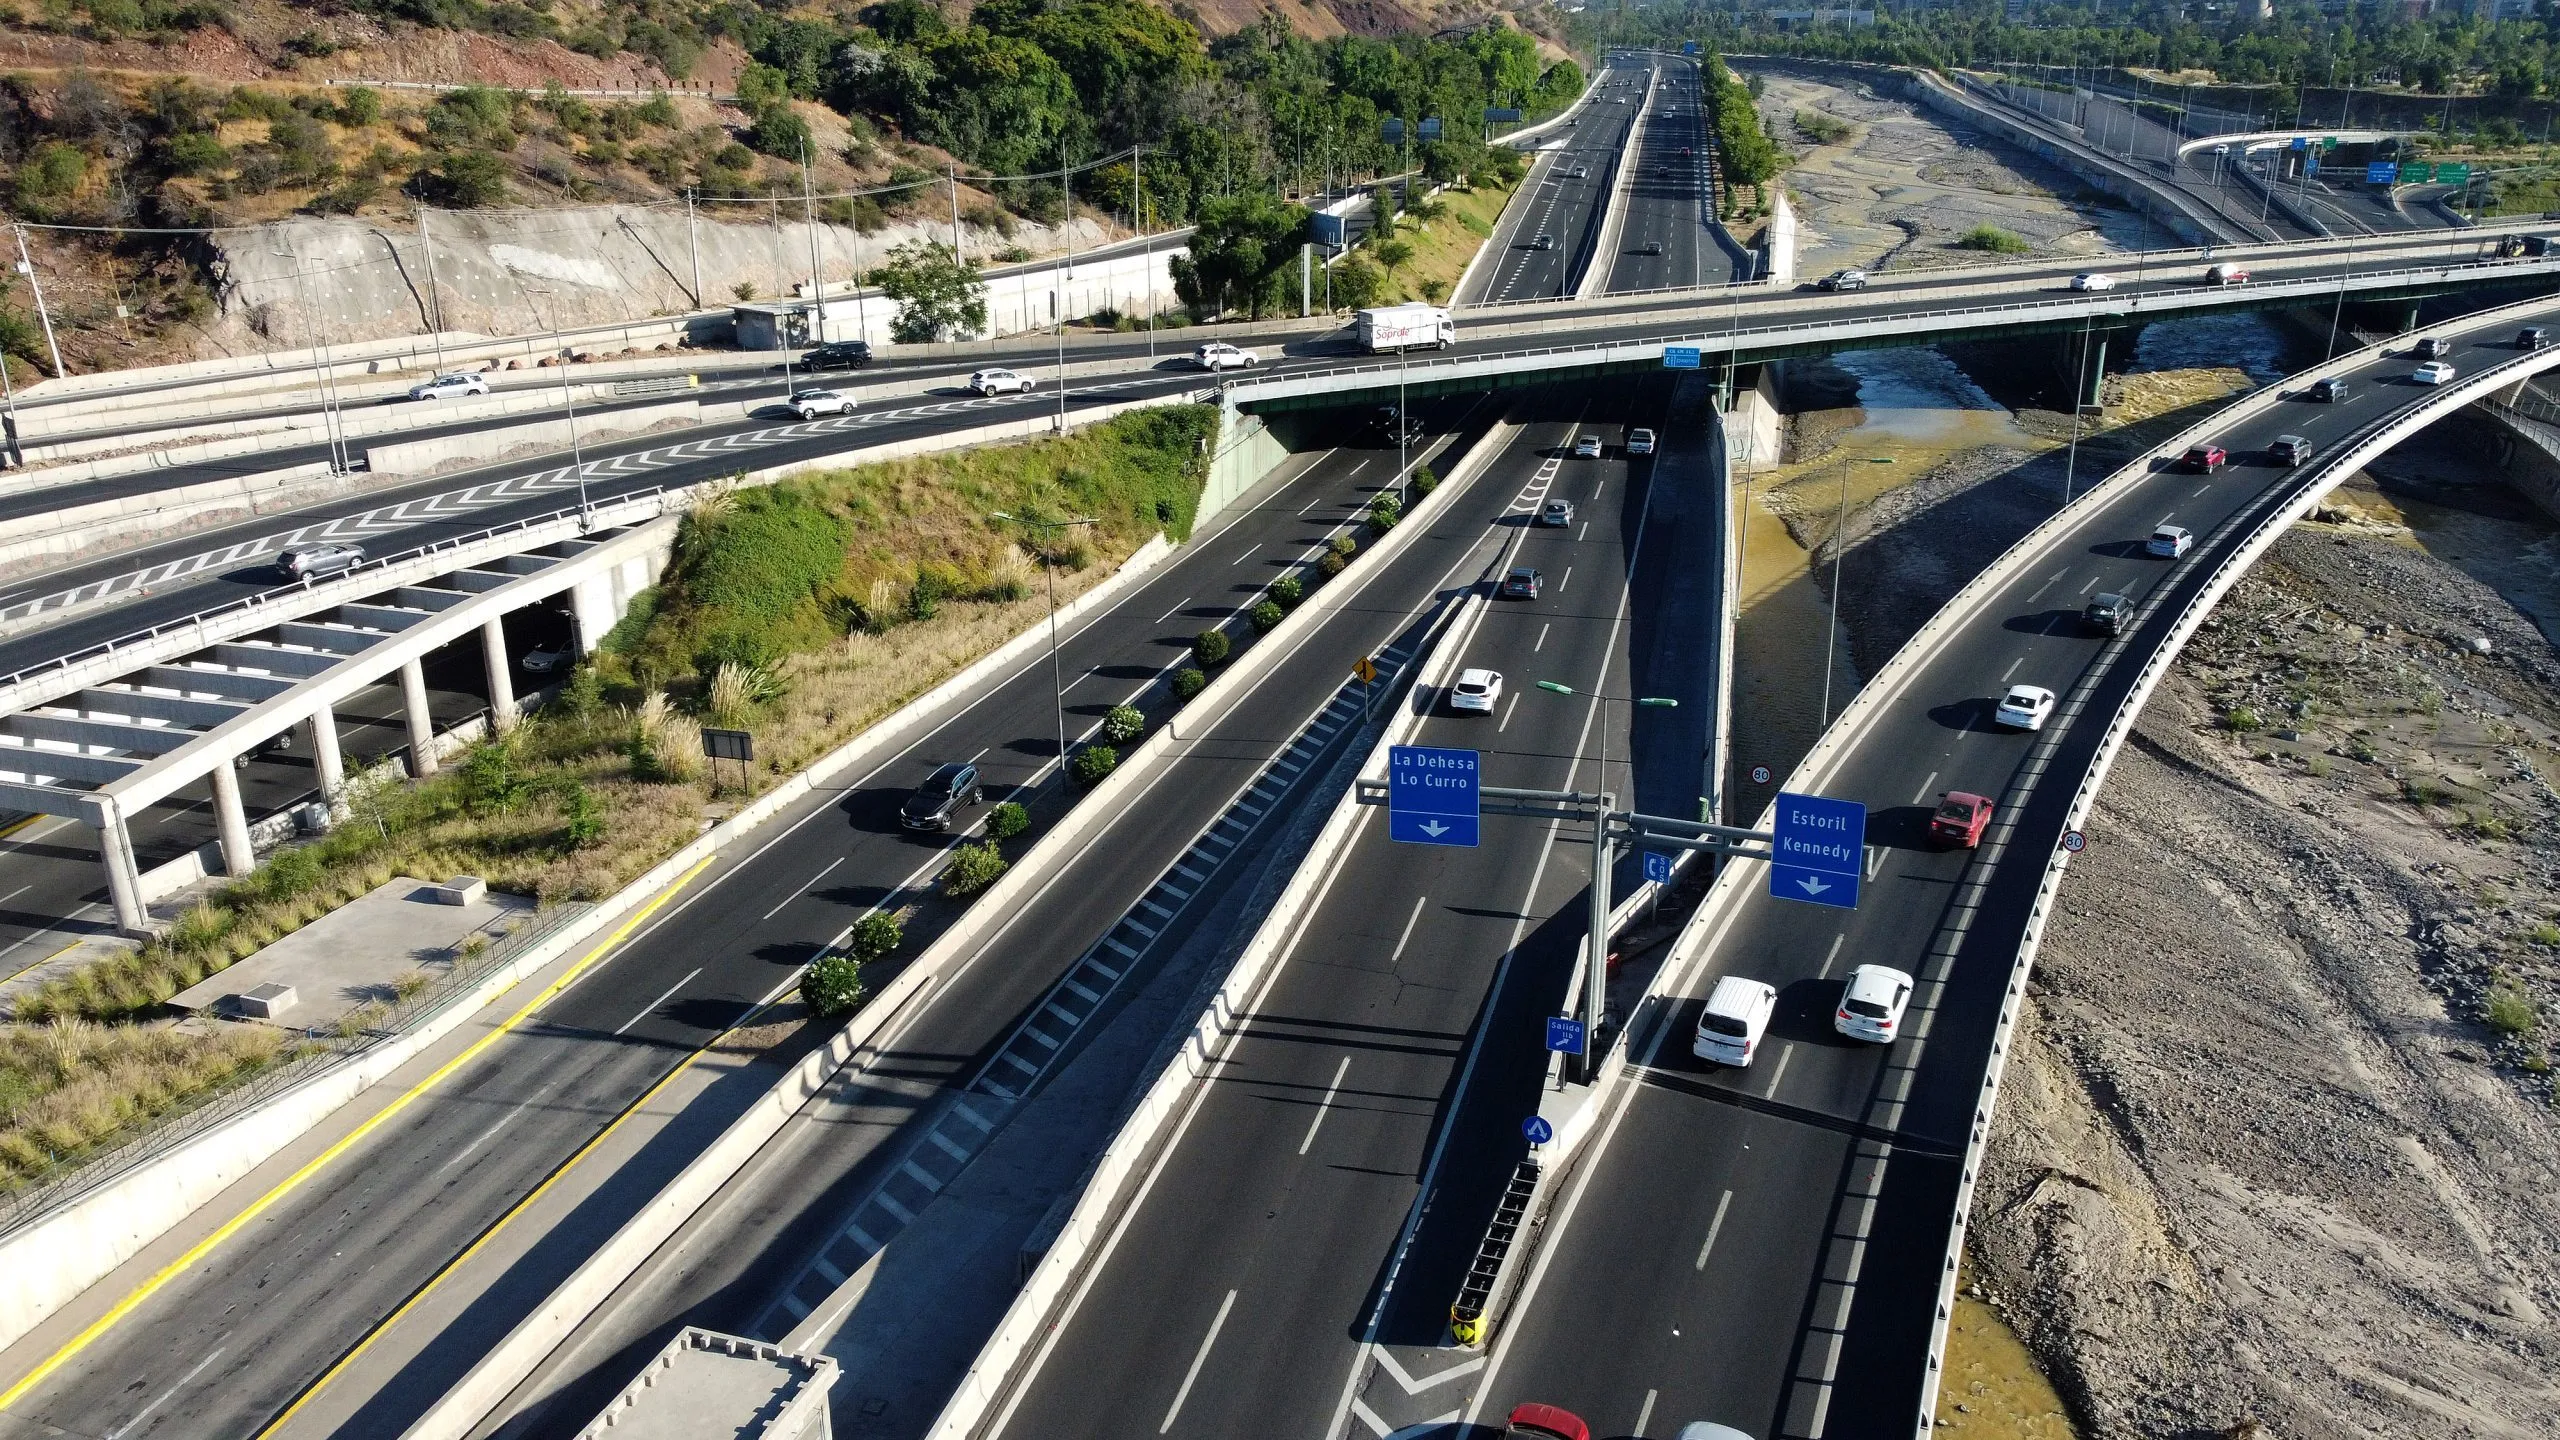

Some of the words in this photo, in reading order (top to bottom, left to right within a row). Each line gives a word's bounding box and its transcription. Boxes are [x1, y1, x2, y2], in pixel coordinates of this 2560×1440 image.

[1394, 753, 1410, 766] La
[1418, 754, 1474, 770] Dehesa
[1401, 772, 1418, 785] Lo
[1425, 774, 1467, 788] Curro
[1754, 769, 1769, 780] 80
[1792, 810, 1846, 831] Estoril
[1783, 836, 1850, 861] Kennedy
[2066, 836, 2082, 848] 80
[1551, 1021, 1580, 1033] Salida
